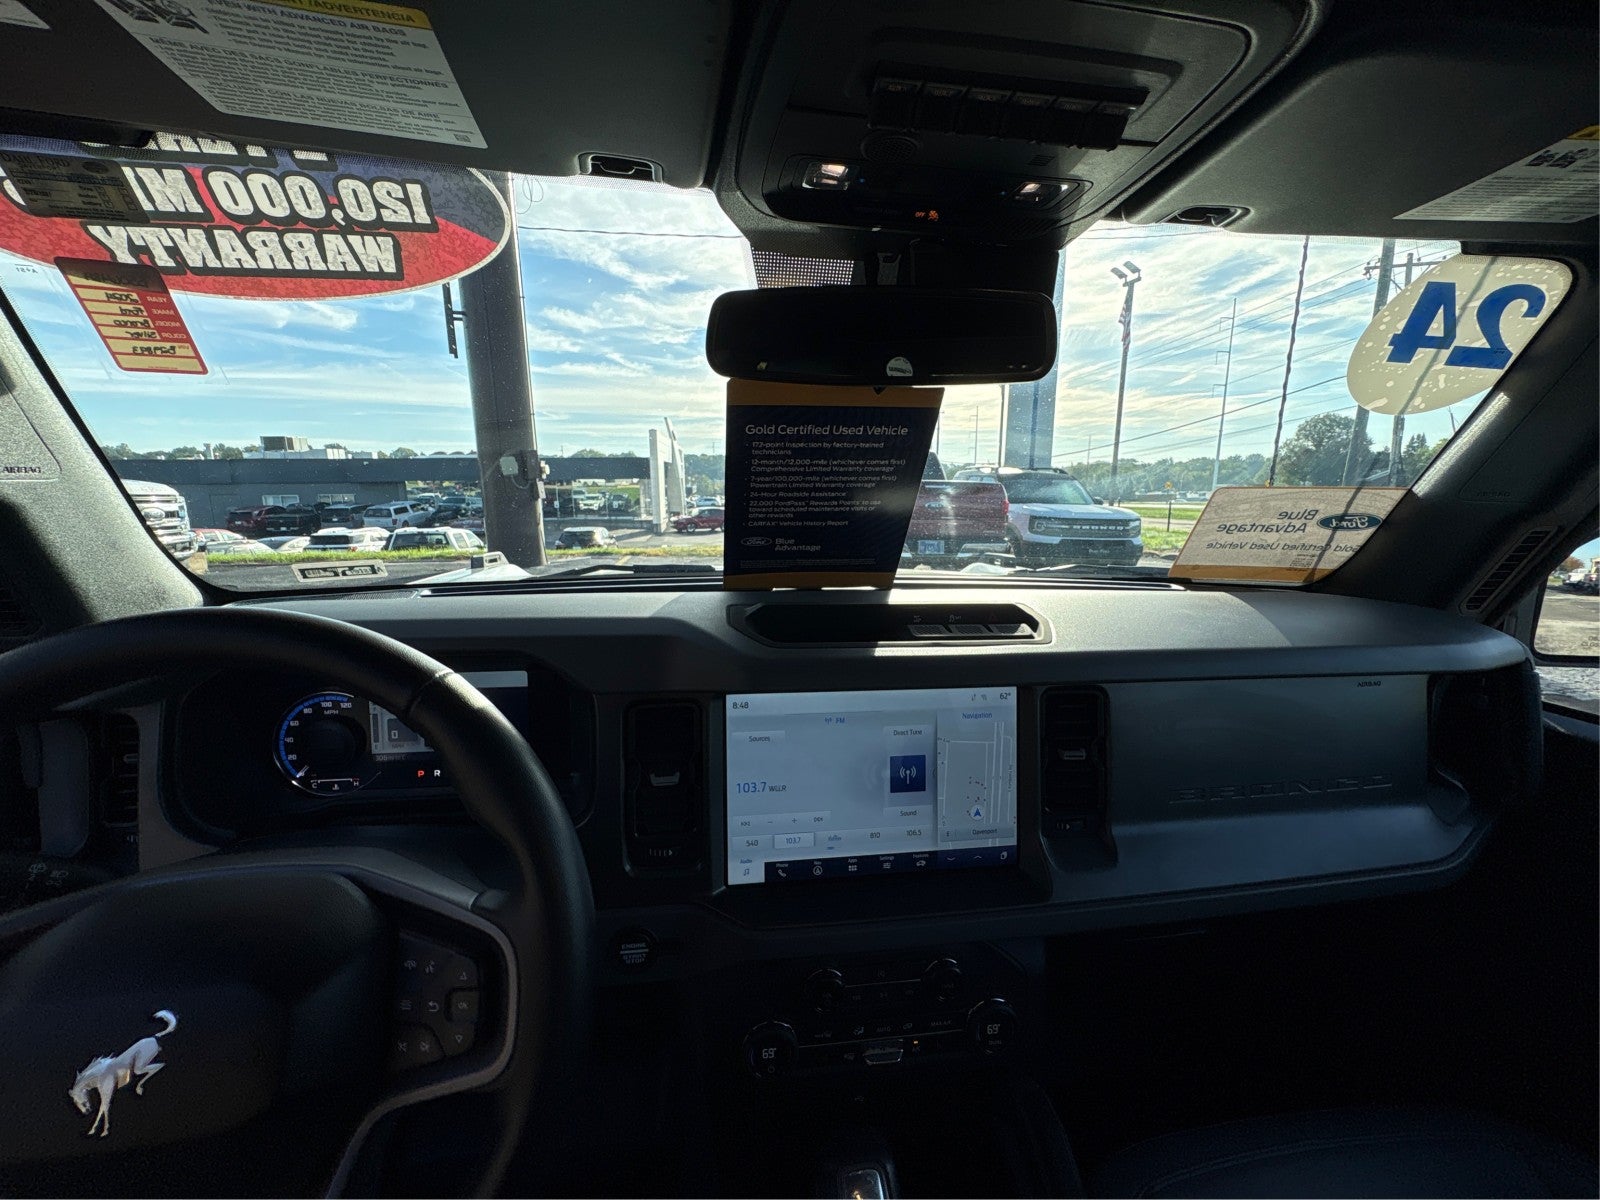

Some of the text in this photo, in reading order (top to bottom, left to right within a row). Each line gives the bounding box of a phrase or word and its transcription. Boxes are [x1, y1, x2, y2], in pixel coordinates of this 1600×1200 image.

[280, 10, 347, 27] ADVANCED
[349, 21, 370, 31] AIR
[371, 25, 407, 36] BAGS
[745, 425, 908, 436] Gold Certified Used Vehicle
[775, 544, 821, 553] Advantage
[962, 712, 993, 720] Navigation
[391, 730, 399, 739] 0
[418, 770, 425, 778] P
[736, 781, 767, 793] 103.7
[972, 828, 998, 836] Davenport
[785, 837, 801, 845] 103.7
